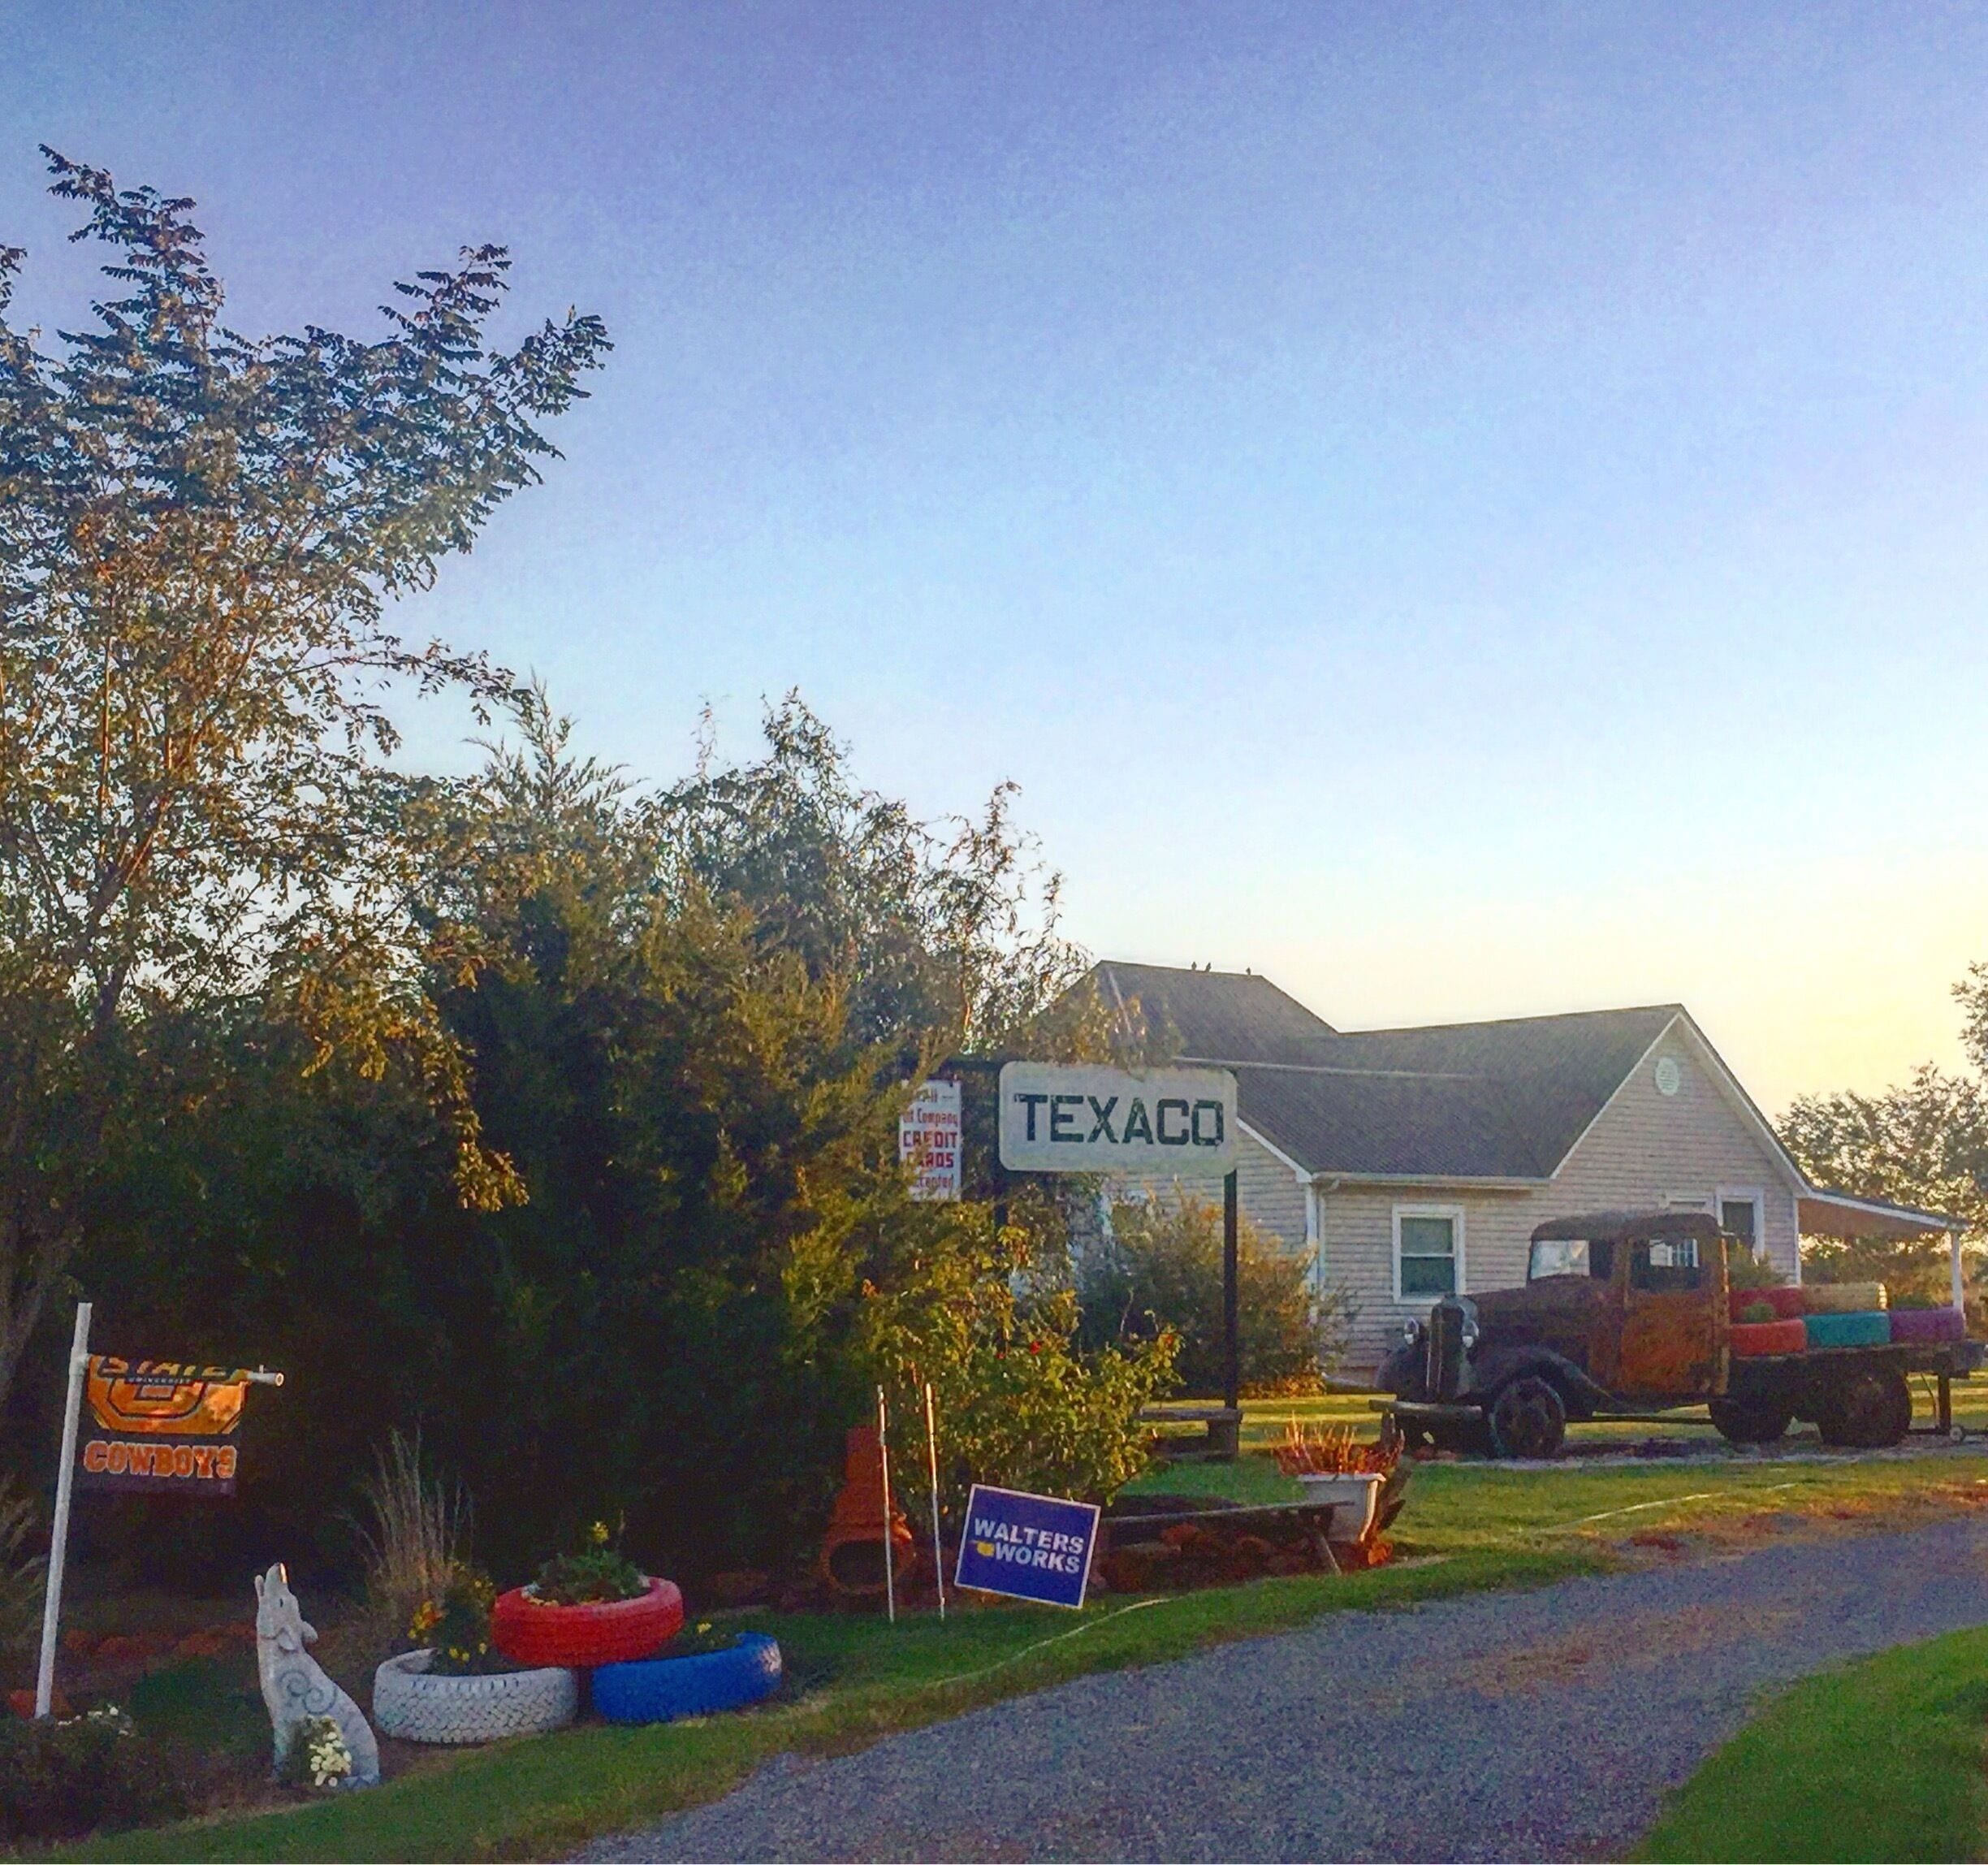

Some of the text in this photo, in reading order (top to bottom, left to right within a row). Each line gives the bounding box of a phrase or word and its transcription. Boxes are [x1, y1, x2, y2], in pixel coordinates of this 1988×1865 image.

[917, 1108, 958, 1127] Company
[1014, 1093, 1225, 1146] TEXACO
[903, 1130, 958, 1149] CREDIT
[84, 1440, 237, 1479] COWBOYS
[975, 1517, 1085, 1555] WALTERS
[995, 1541, 1081, 1574] WORKS
